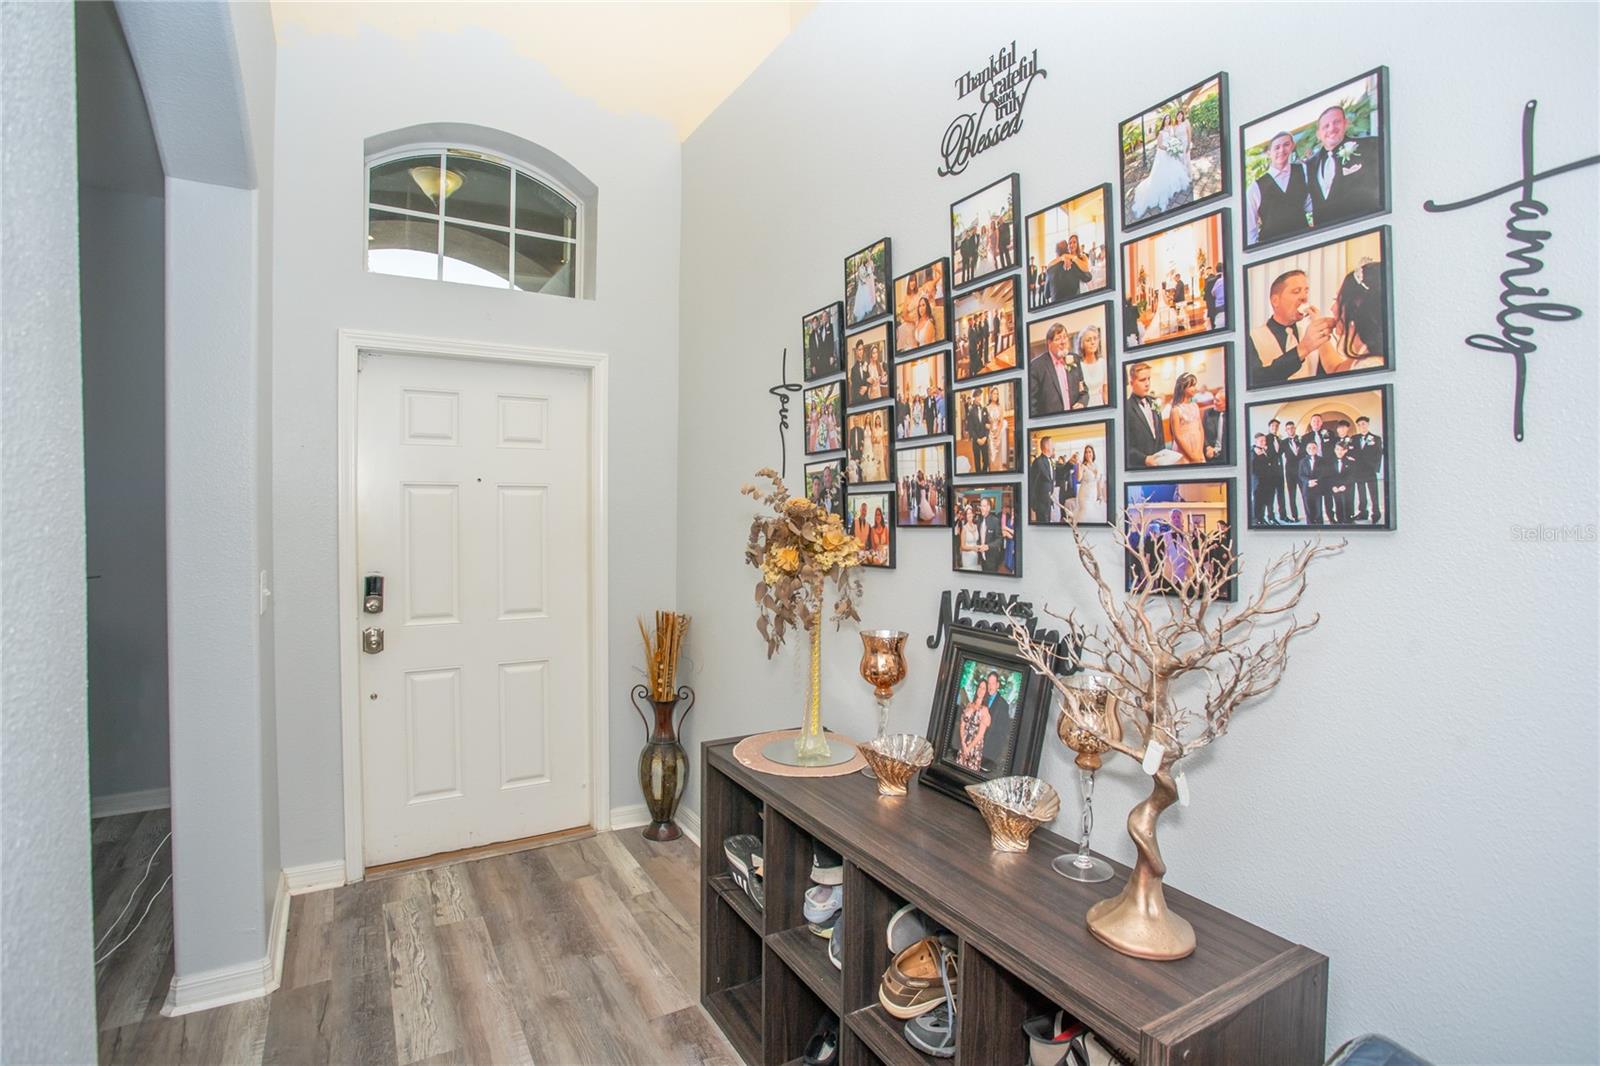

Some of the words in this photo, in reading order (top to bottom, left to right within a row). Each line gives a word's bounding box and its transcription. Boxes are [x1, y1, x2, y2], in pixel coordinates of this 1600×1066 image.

[955, 40, 1016, 101] Thankful
[980, 48, 1037, 104] Grateful
[938, 69, 1047, 177] Blessed
